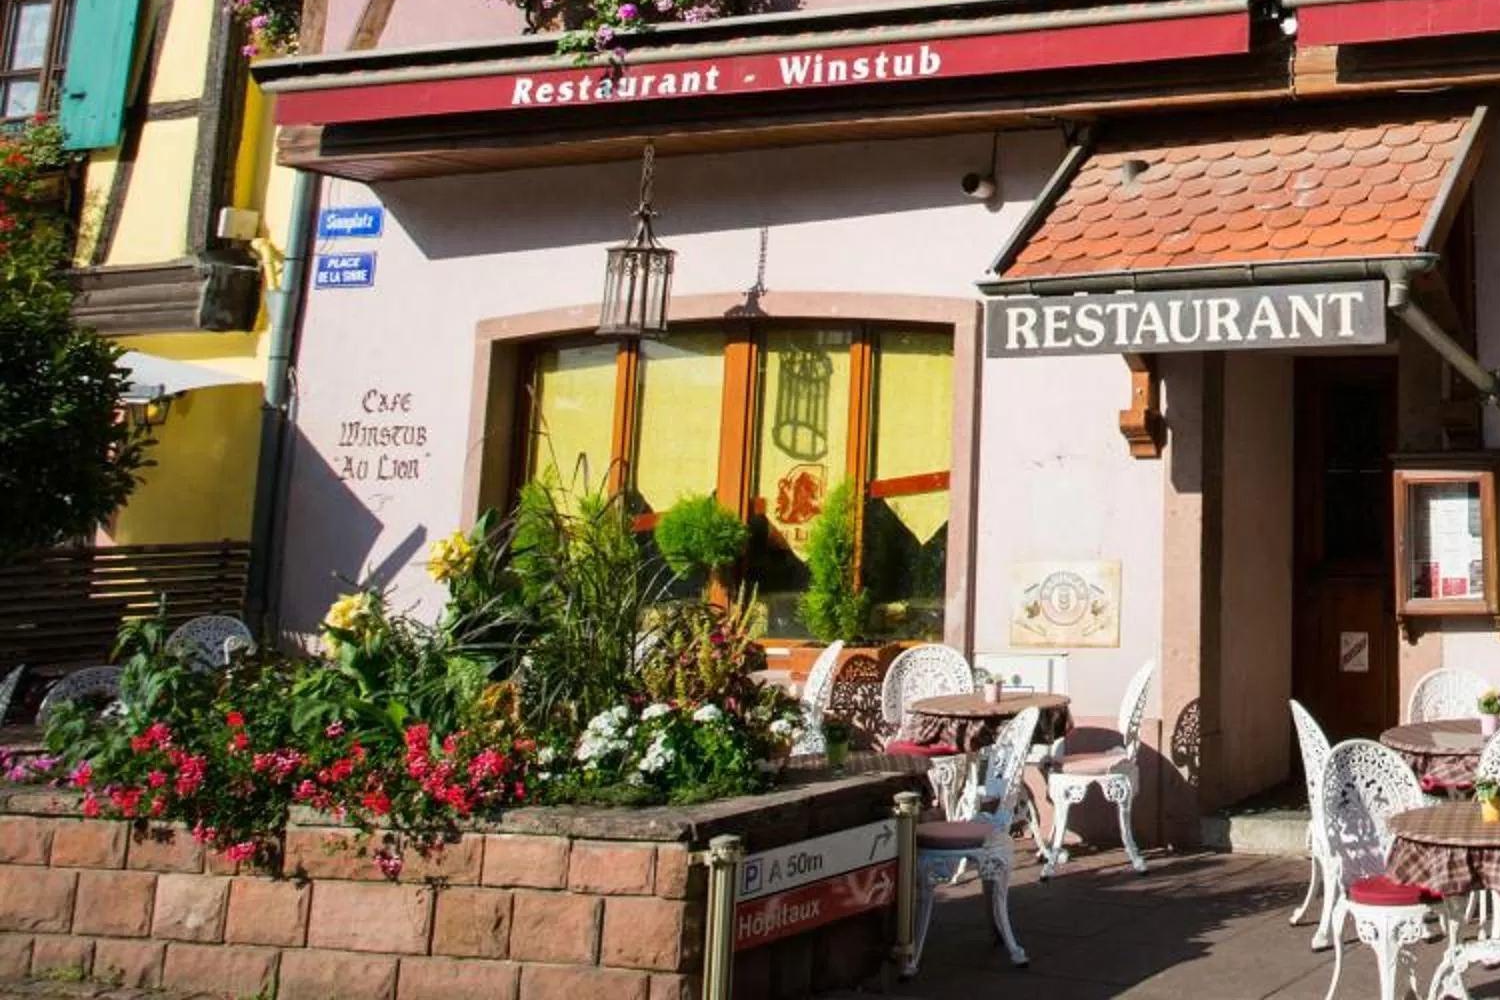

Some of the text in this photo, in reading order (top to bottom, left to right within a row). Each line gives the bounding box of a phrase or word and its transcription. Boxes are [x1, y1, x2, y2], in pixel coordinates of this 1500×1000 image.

[511, 64, 720, 105] Restaurant
[778, 45, 941, 86] Winstub
[327, 257, 361, 269] PLACE
[1005, 291, 1363, 350] RESTAURANT
[787, 851, 823, 878] 50m
